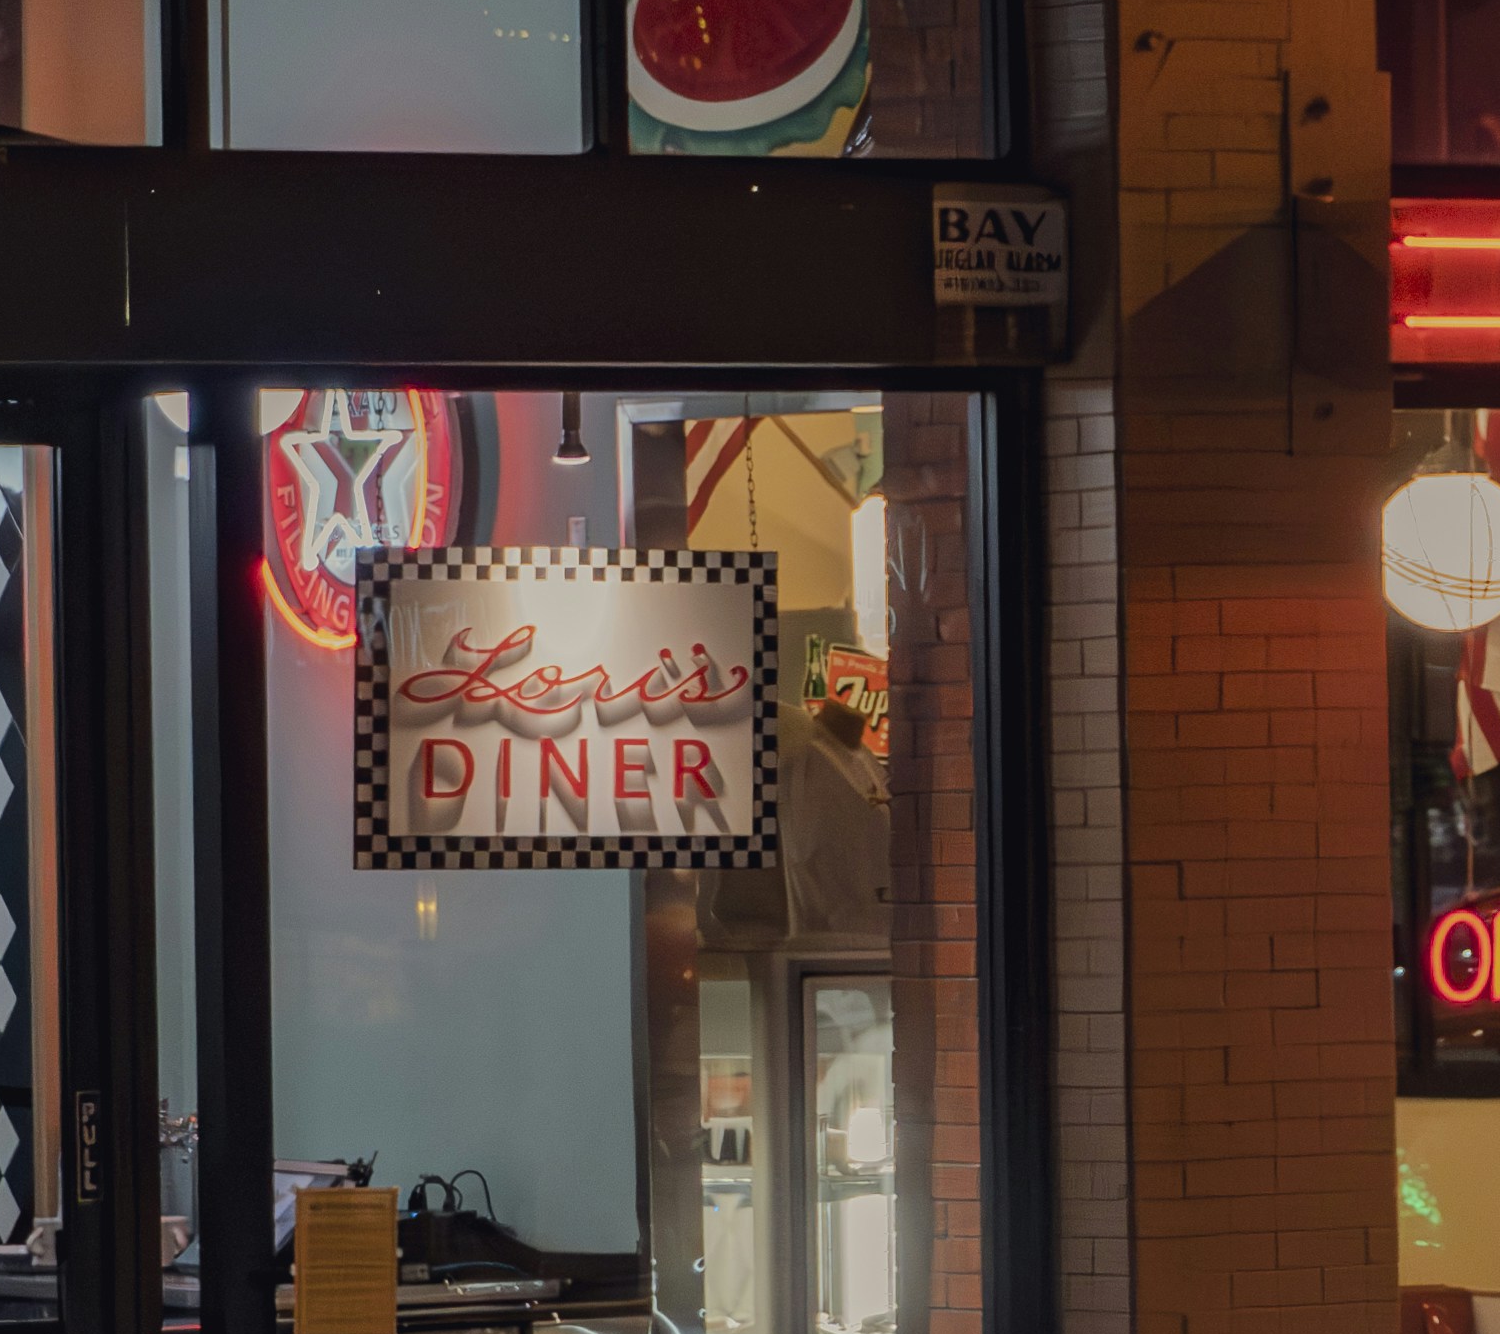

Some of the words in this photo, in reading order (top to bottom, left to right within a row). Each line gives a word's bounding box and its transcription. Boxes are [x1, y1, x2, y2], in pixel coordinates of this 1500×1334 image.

[935, 249, 996, 271] URGLAR
[939, 207, 1046, 246] BAY
[277, 484, 351, 629] FILLING
[398, 624, 749, 715] Lori's
[422, 738, 719, 800] DINER
[80, 1100, 99, 1194] PULL
